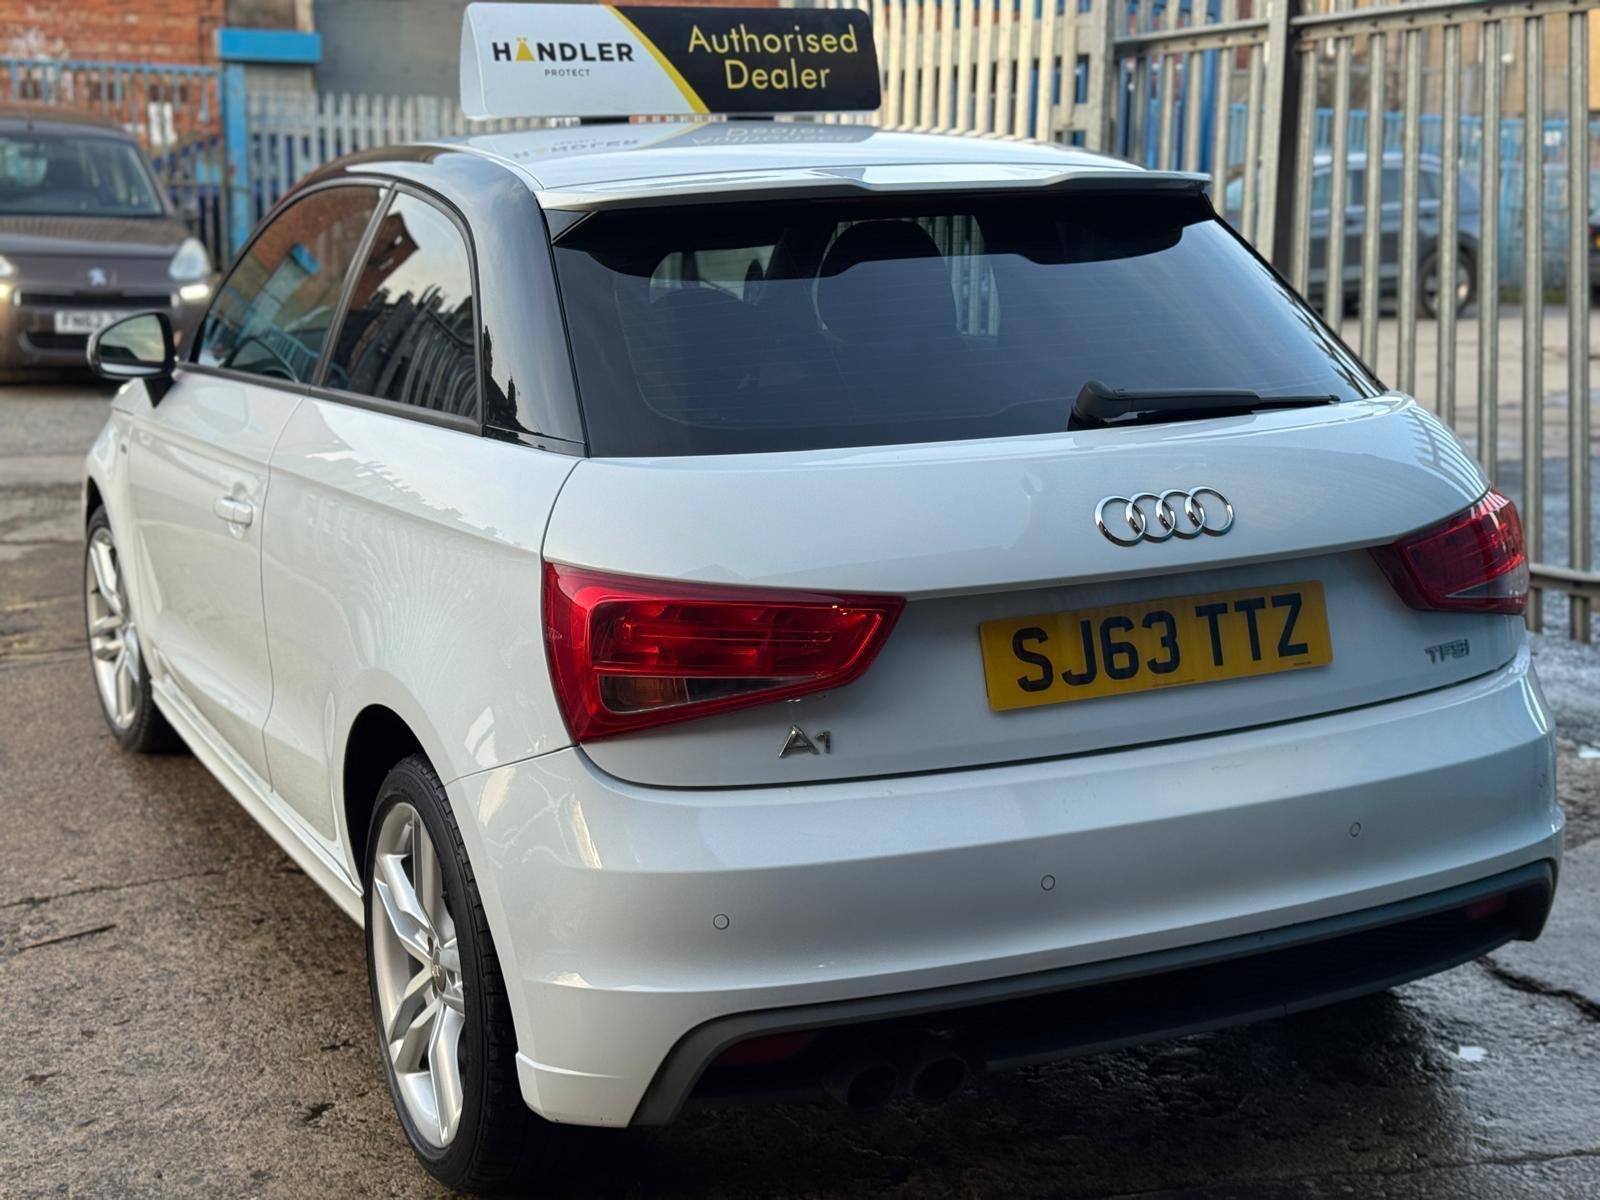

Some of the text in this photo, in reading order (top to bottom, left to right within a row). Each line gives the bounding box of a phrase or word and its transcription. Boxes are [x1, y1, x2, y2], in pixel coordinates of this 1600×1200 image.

[688, 23, 858, 53] Authorised
[544, 68, 591, 77] PROTECT
[724, 57, 831, 89] Dealer
[1012, 593, 1309, 692] SJ63 TTZ
[778, 724, 832, 759] A1
